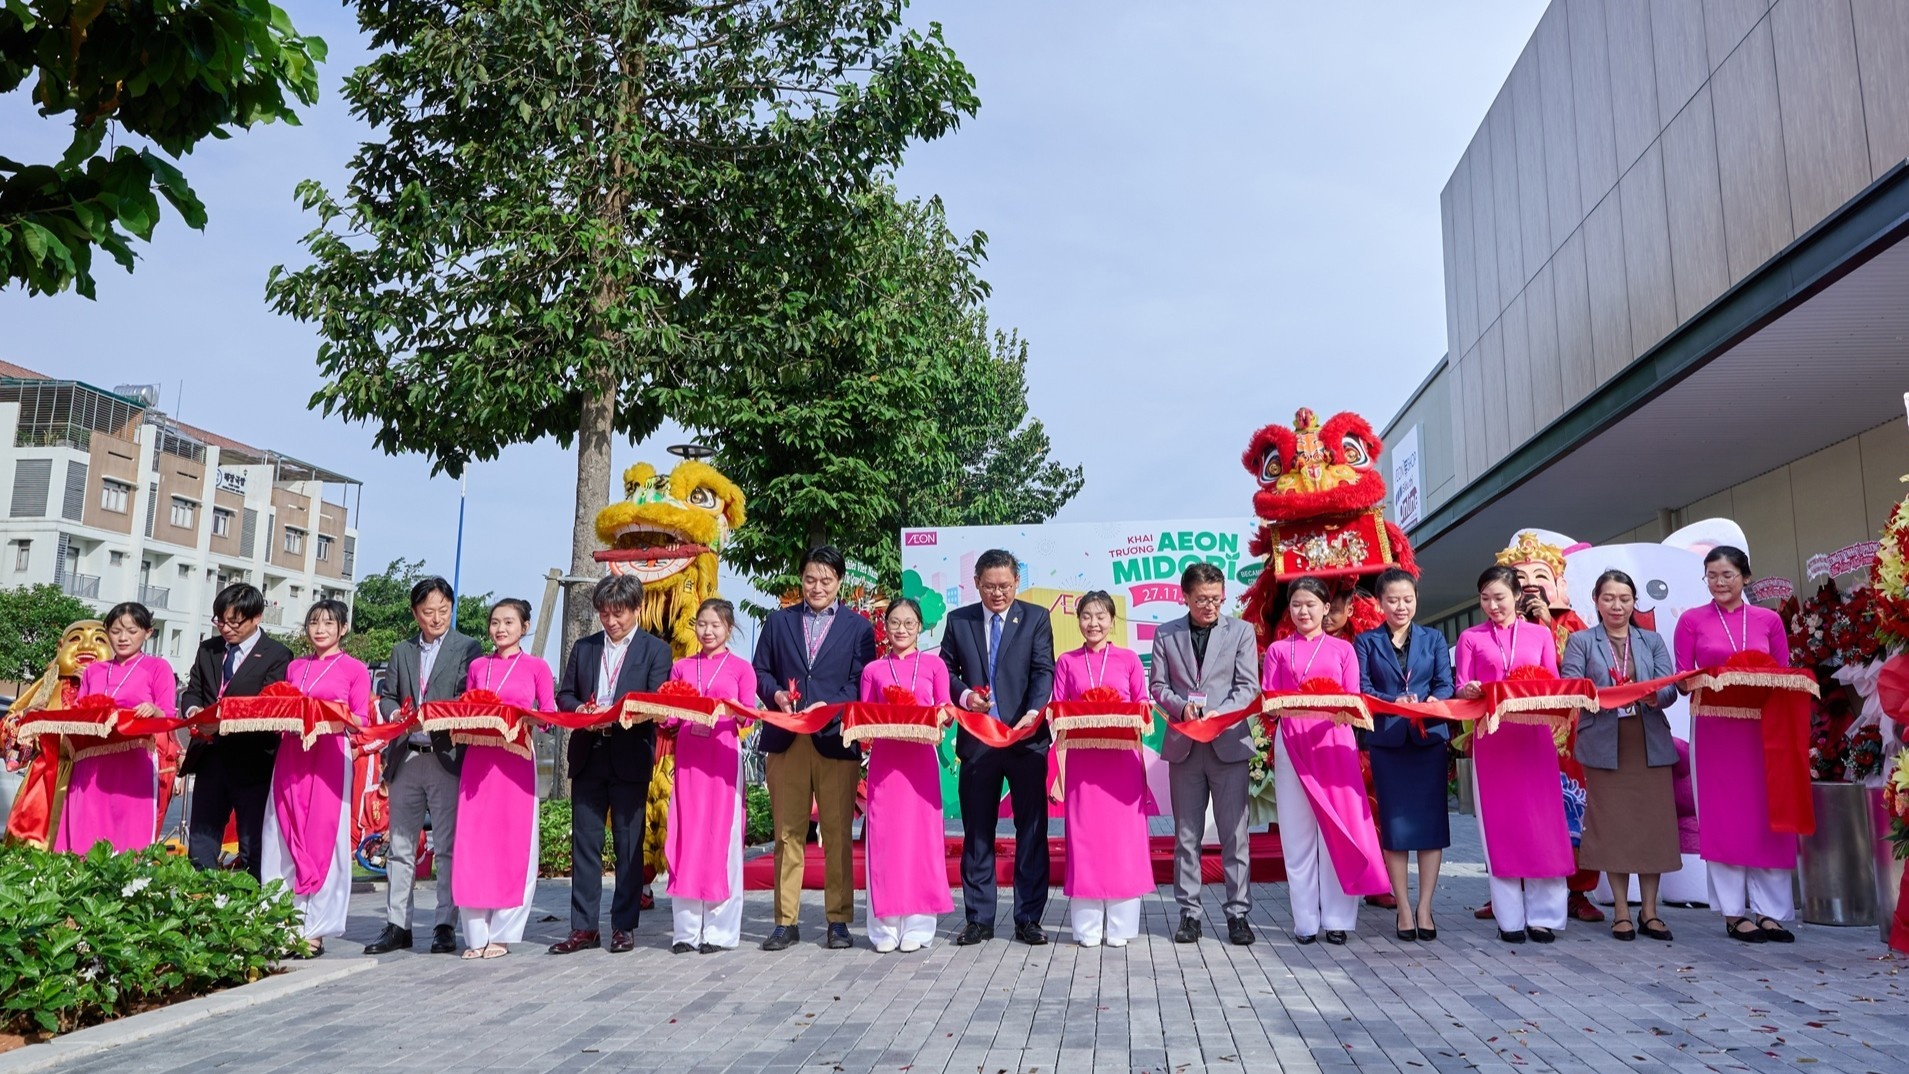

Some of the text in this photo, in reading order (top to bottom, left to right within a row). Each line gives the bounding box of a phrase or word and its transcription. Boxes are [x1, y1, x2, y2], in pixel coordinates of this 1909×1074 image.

[1127, 534, 1153, 544] KHAI
[1157, 531, 1238, 553] AEON
[1142, 587, 1185, 602] 27.11.
